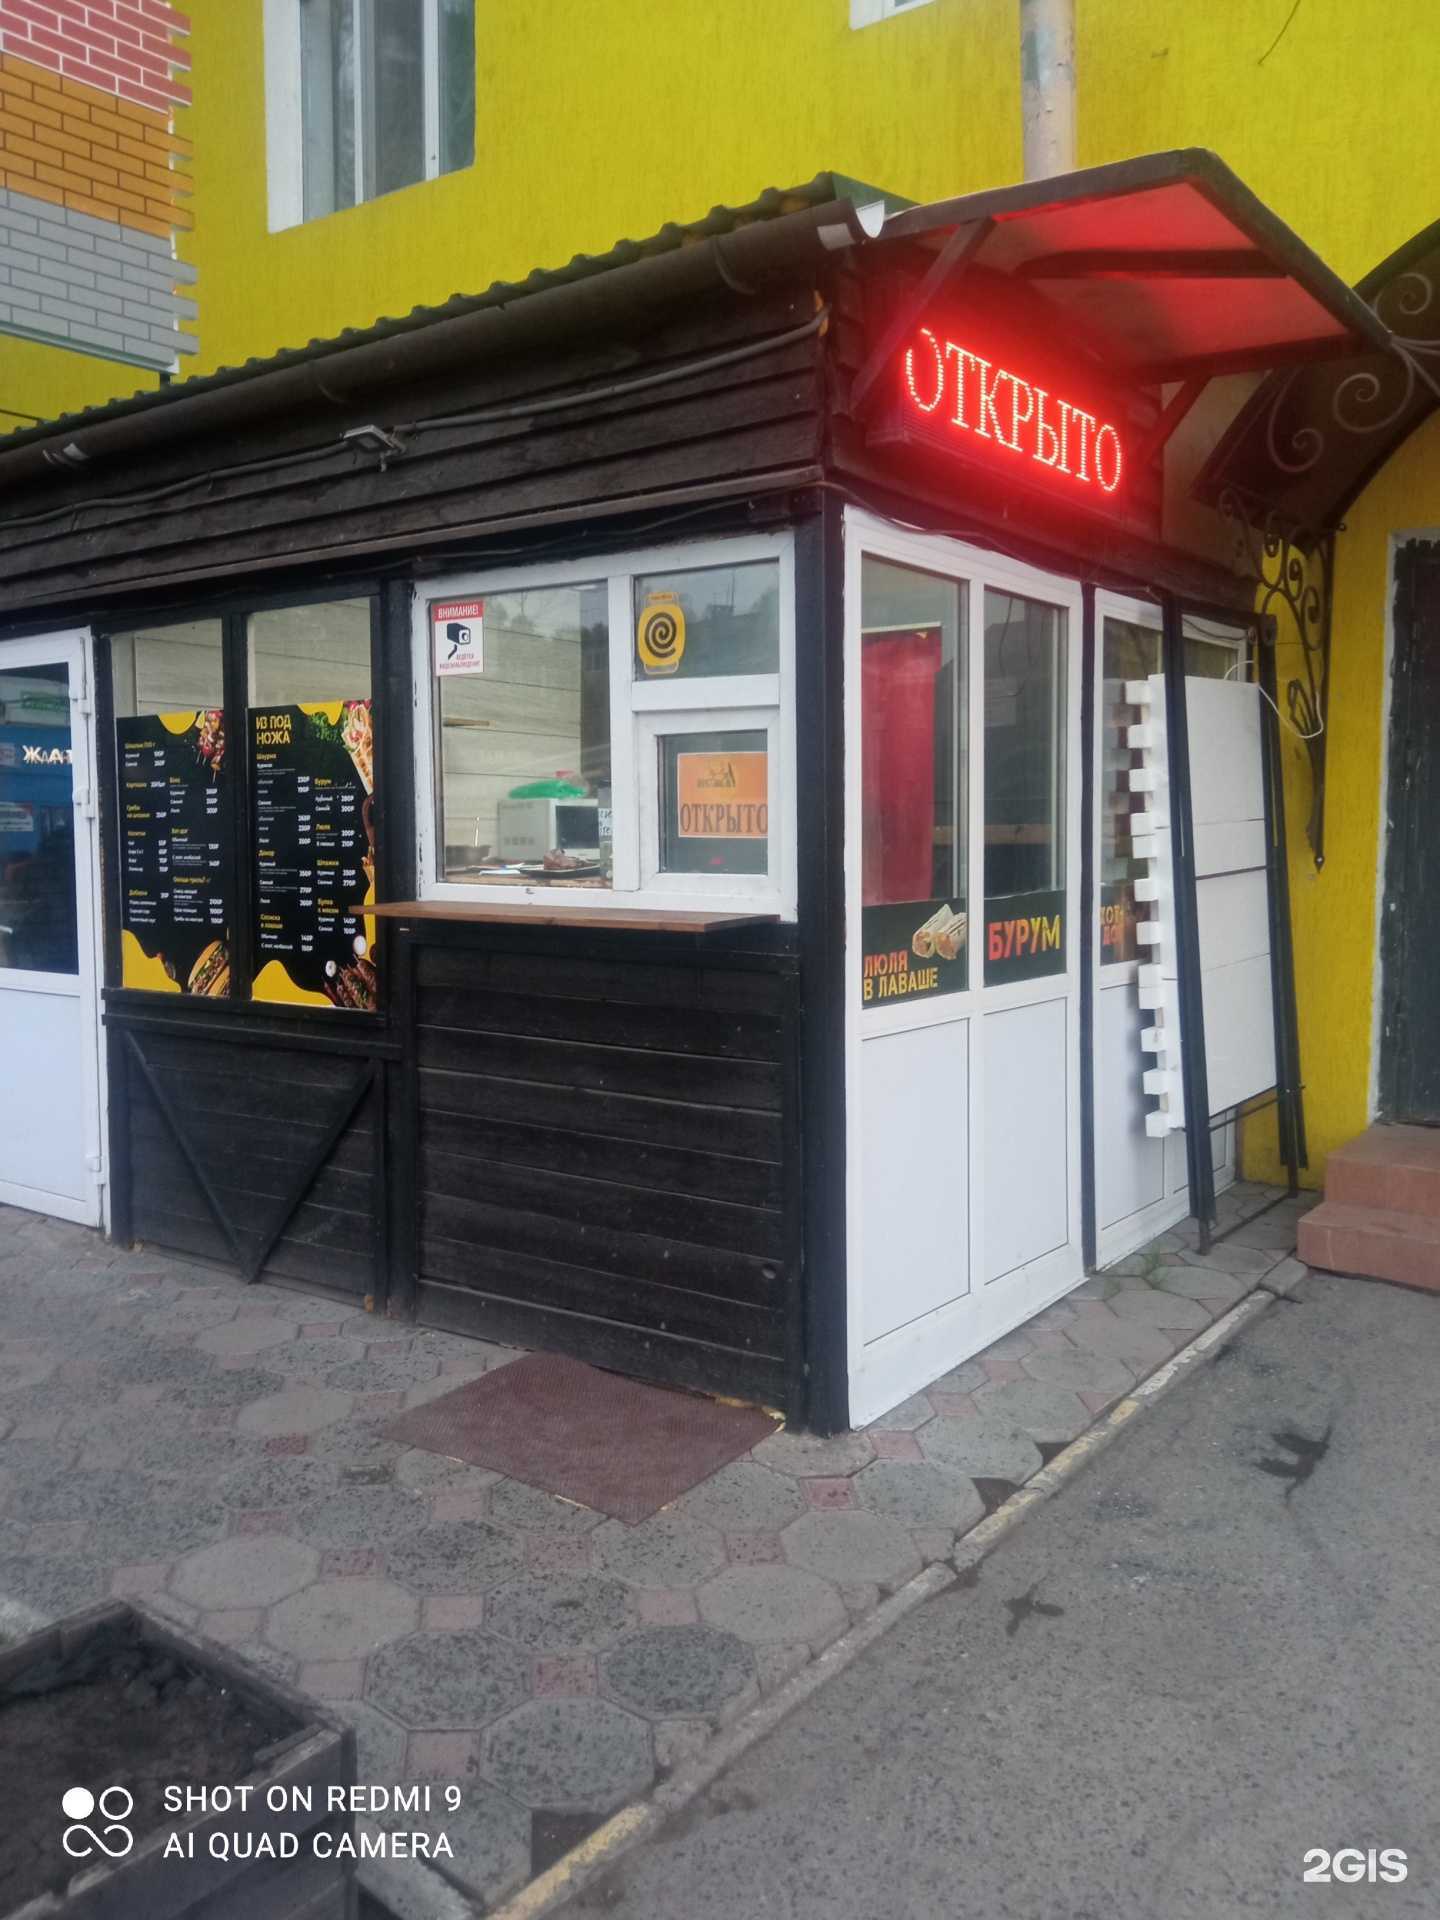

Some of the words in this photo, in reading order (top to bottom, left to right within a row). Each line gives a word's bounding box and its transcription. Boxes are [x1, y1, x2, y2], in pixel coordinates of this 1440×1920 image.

[905, 327, 1122, 492] ОТКРЫТО
[438, 603, 480, 620] ВНИМАНИЕ!
[256, 716, 268, 730] ИЗ
[269, 714, 292, 731] ПОД
[256, 730, 291, 745] НОЖА
[681, 803, 768, 833] ОТКРЫТО
[987, 914, 1061, 961] БУРУМ
[863, 950, 908, 978] ЛЮЛЯ
[863, 977, 873, 1000] В
[878, 966, 938, 998] ЛАВАШЕ
